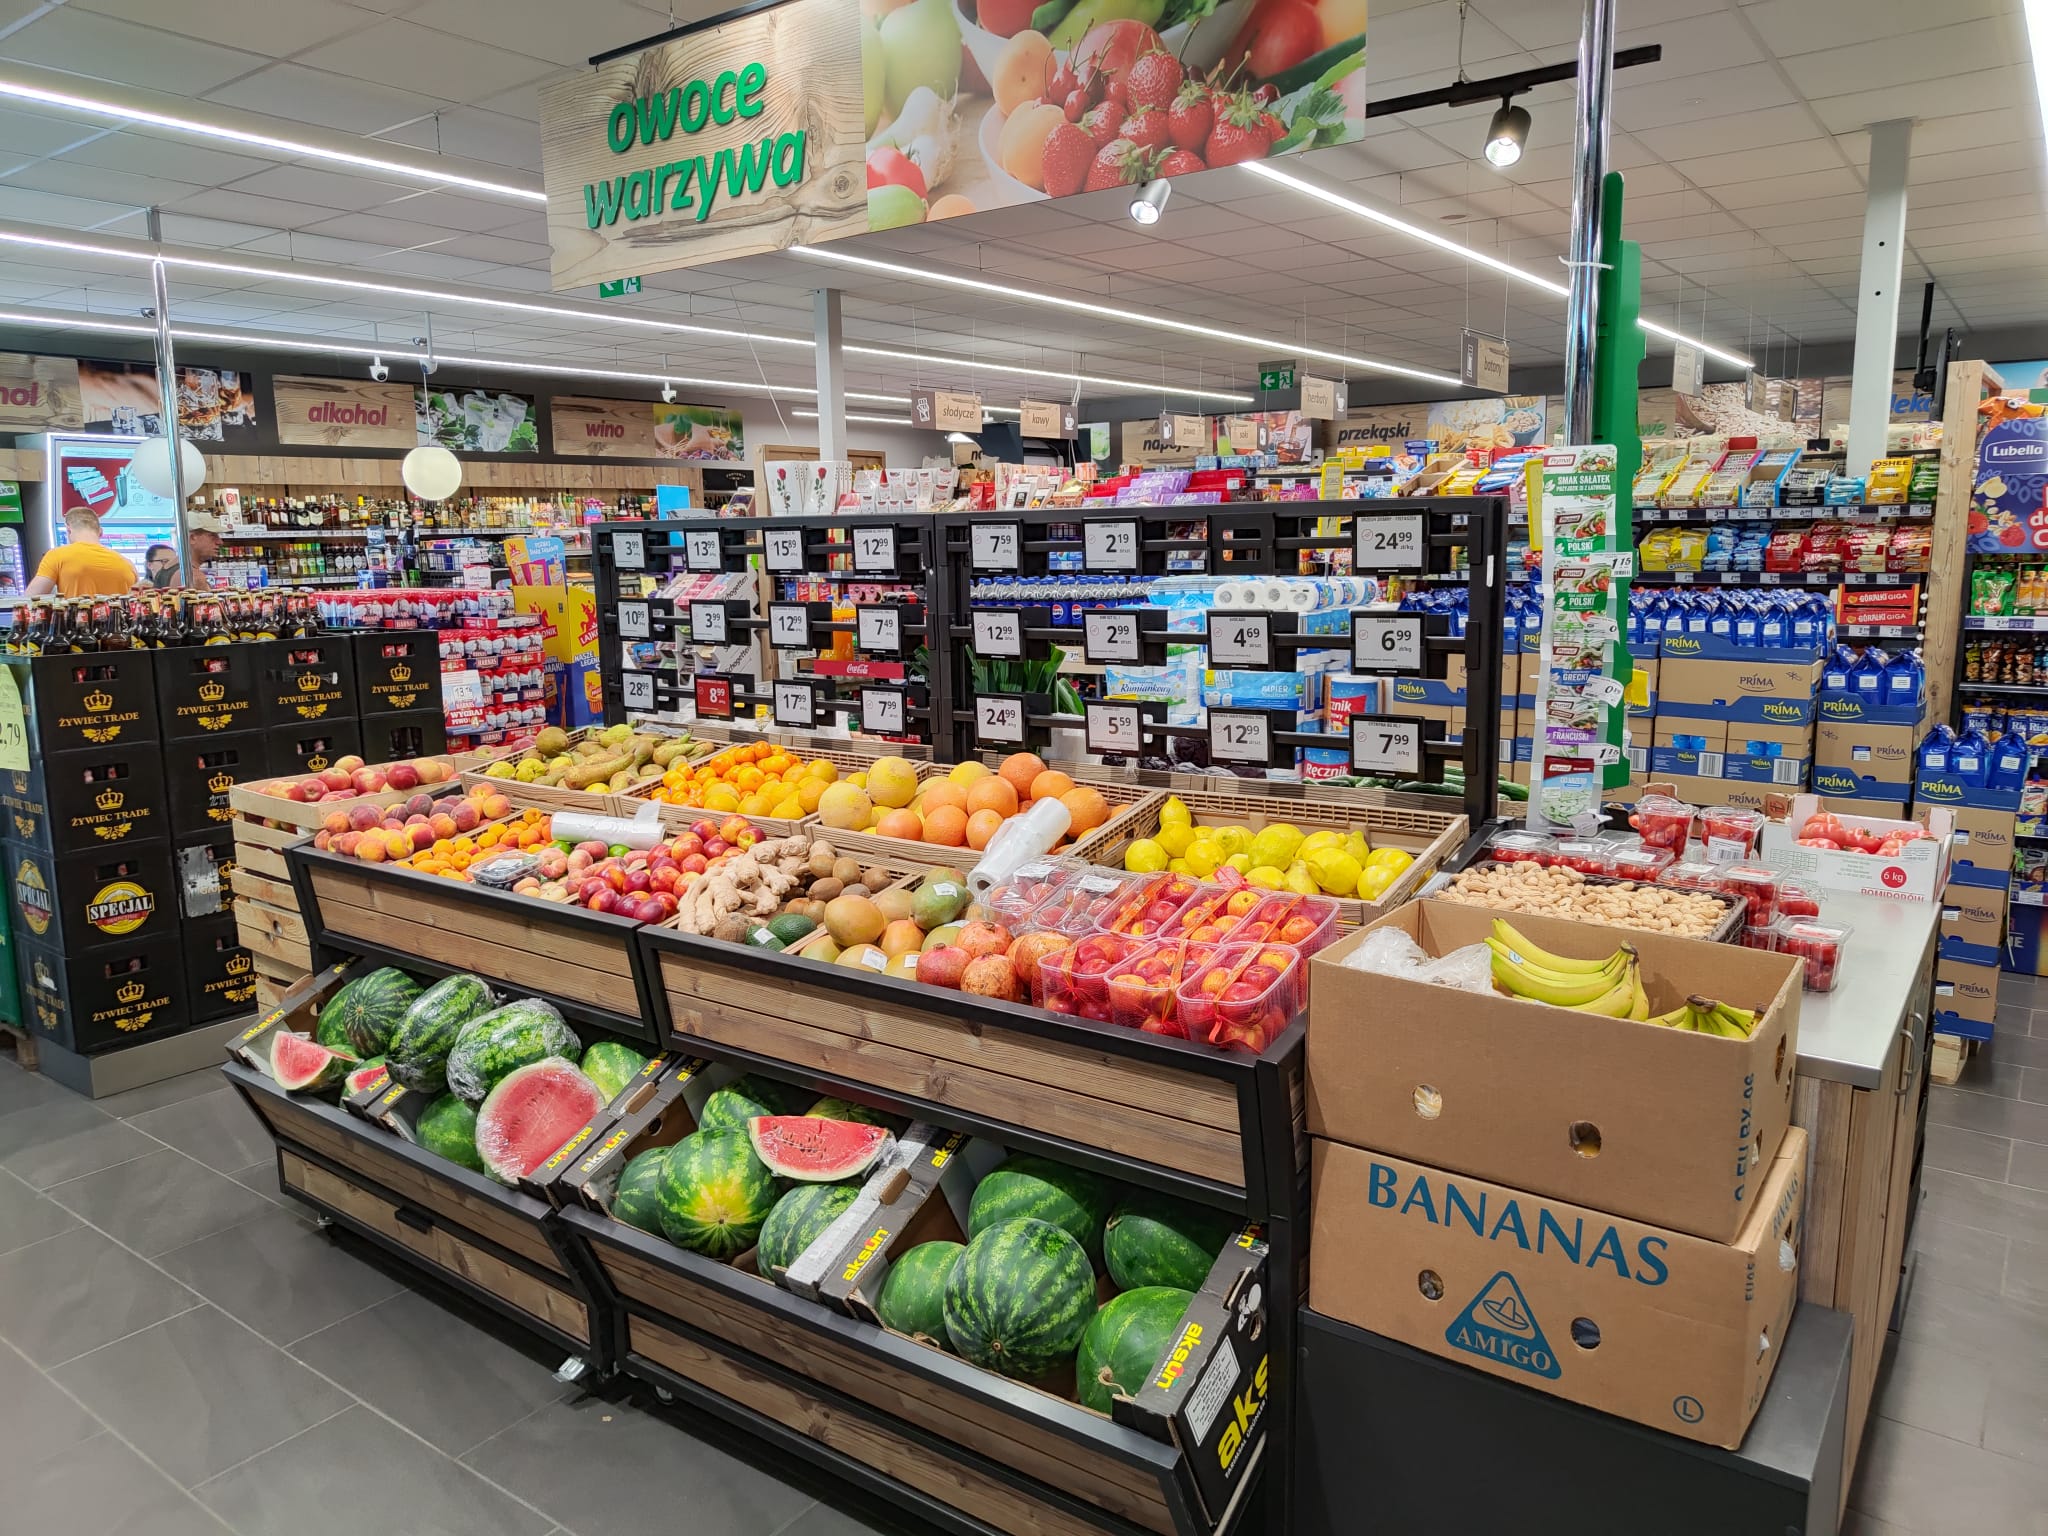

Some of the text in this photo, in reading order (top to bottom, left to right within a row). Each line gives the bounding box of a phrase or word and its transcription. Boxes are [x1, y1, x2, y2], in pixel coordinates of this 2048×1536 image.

[607, 62, 767, 154] owoce
[583, 129, 807, 230] warzywa
[308, 401, 388, 427] alkohol
[942, 406, 975, 421] słodycze
[1031, 414, 1050, 427] kawy
[585, 420, 625, 438] wino
[1337, 422, 1411, 445] przekąski
[1992, 444, 2043, 457] Lubella
[1557, 475, 1610, 485] SMAK SAŁATEK
[1567, 541, 1593, 551] POLSKI
[1569, 597, 1595, 606] POLSKI
[371, 681, 429, 695] ŻYWIEC TRADE
[278, 690, 342, 705] ŻYWIEC TRADE
[177, 700, 249, 717] ŻYWIEC TRADE
[58, 711, 140, 728] ŻYWIEC TRADE
[1552, 731, 1589, 741] FRANCUSKI
[1306, 762, 1349, 778] Ręcznik
[71, 807, 150, 828] ŻYWIEC TRADE
[1892, 872, 1904, 883] kg
[90, 895, 153, 922] SPECJAL
[204, 978, 241, 993] ŻYWIEC
[92, 996, 170, 1023] ŻYWIEC TRADE
[1368, 1162, 1669, 1287] BANANAS
[1455, 1326, 1552, 1372] AMIGO
[1681, 1398, 1694, 1418] L
